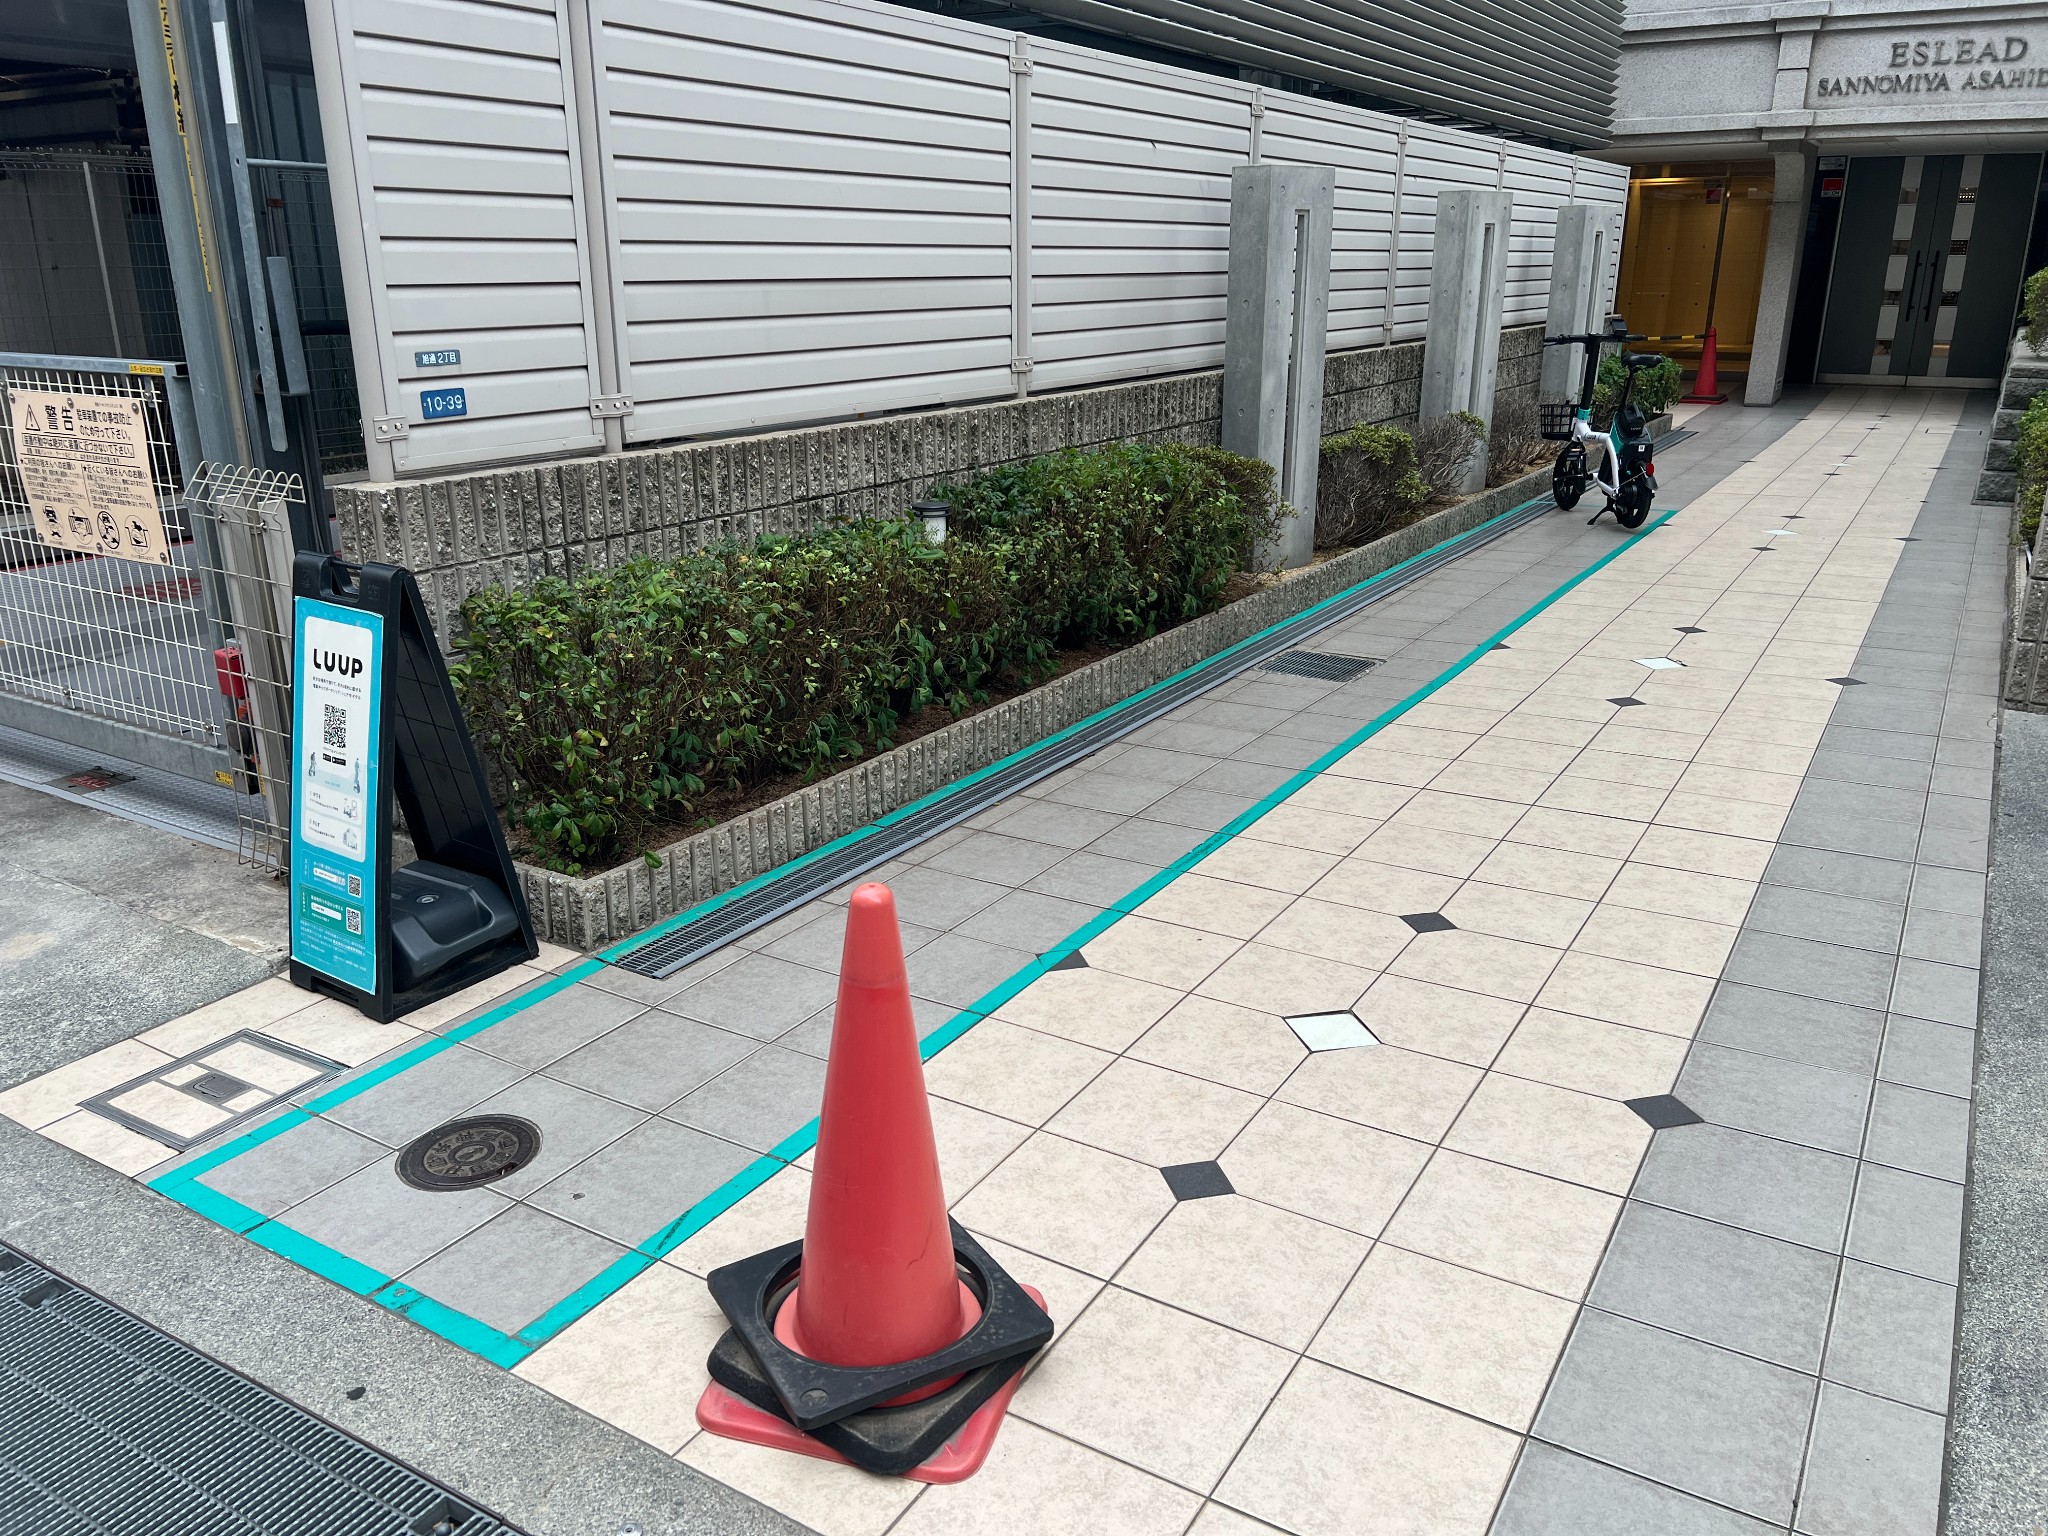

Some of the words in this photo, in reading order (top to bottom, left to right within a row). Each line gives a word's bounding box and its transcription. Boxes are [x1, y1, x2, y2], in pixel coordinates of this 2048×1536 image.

[1888, 36, 2029, 68] ESLEAD
[1817, 72, 1950, 98] SANNOMIYA
[426, 394, 463, 413] 10-39
[44, 404, 74, 432] 警告
[313, 648, 364, 679] LUUP
